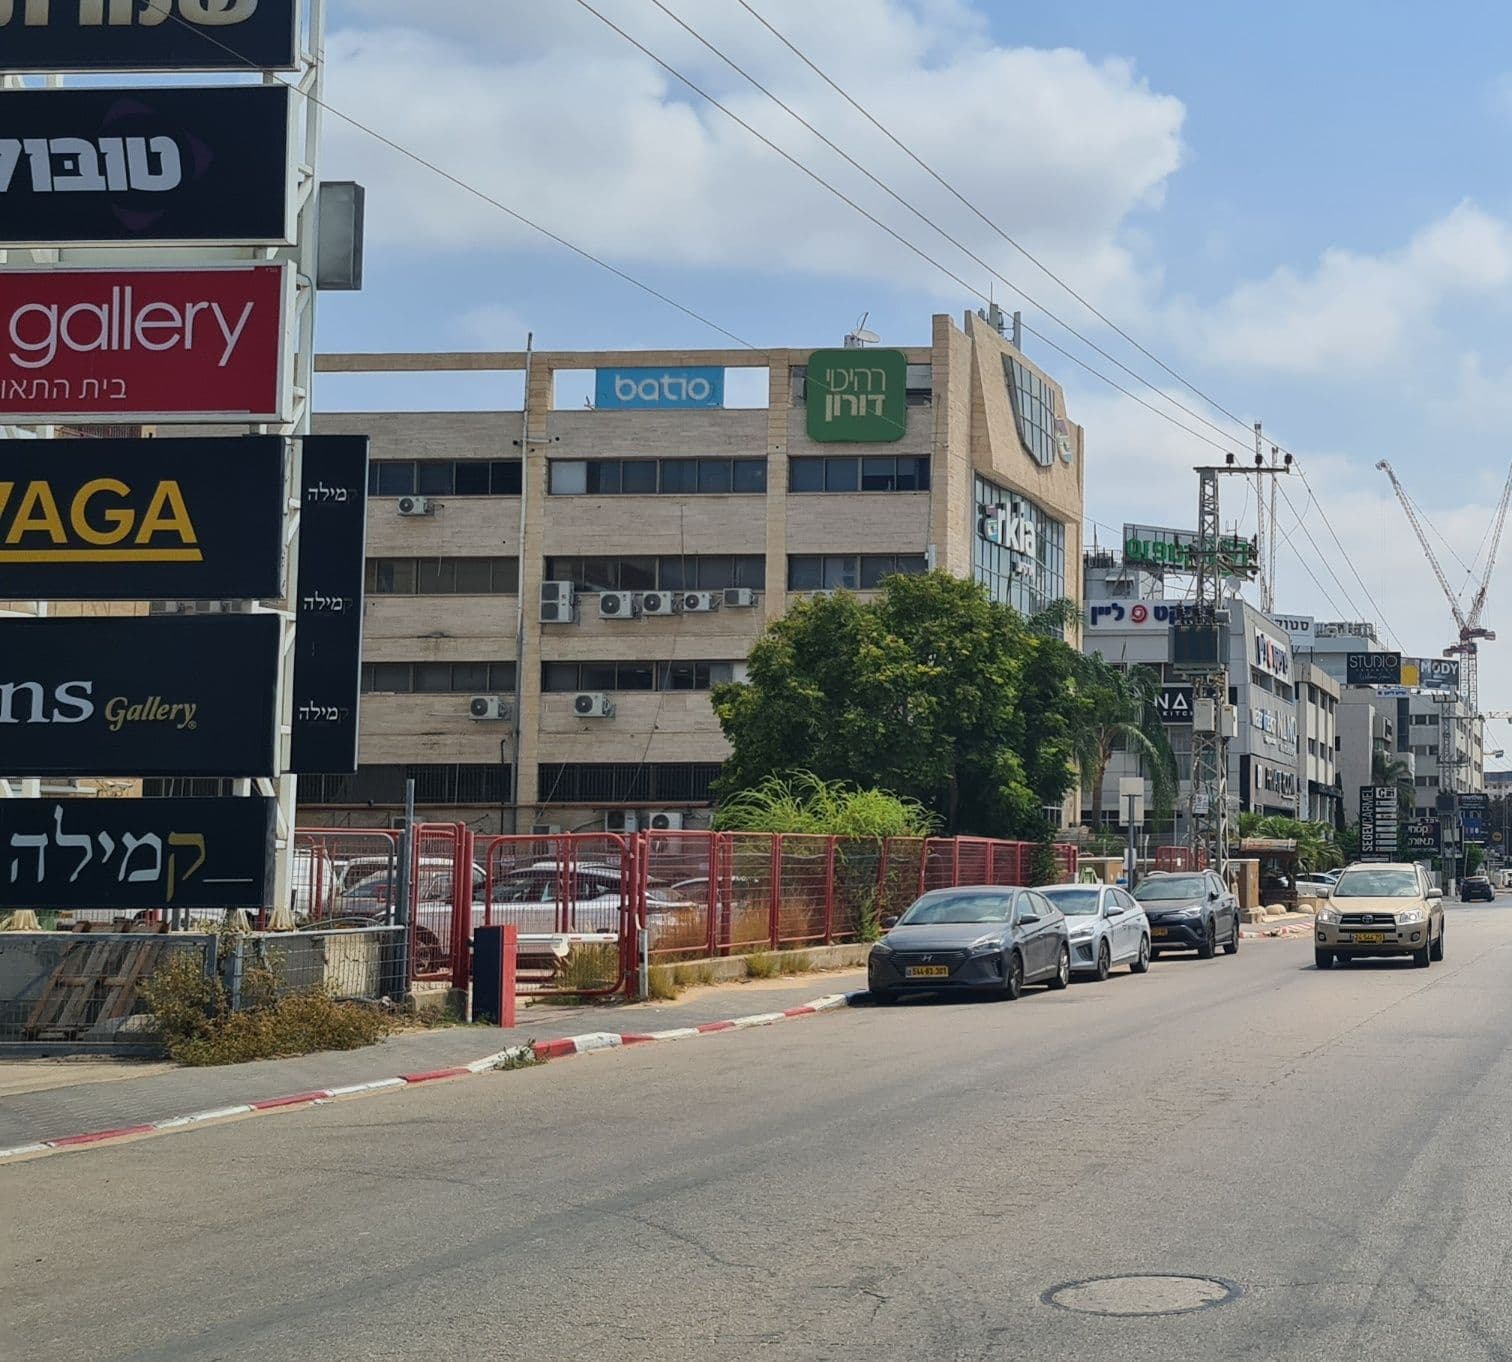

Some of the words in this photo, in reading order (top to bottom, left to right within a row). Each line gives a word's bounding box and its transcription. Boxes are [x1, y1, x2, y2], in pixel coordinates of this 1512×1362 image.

[9, 286, 254, 368] gallery
[0, 378, 69, 399] התאו
[79, 378, 127, 399] בית
[615, 374, 711, 401] batio
[826, 368, 886, 392] רהיטי
[825, 394, 886, 422] דורון
[1350, 655, 1398, 669] STUDIO
[106, 697, 196, 730] Gallery
[8, 804, 207, 903] קמילה
